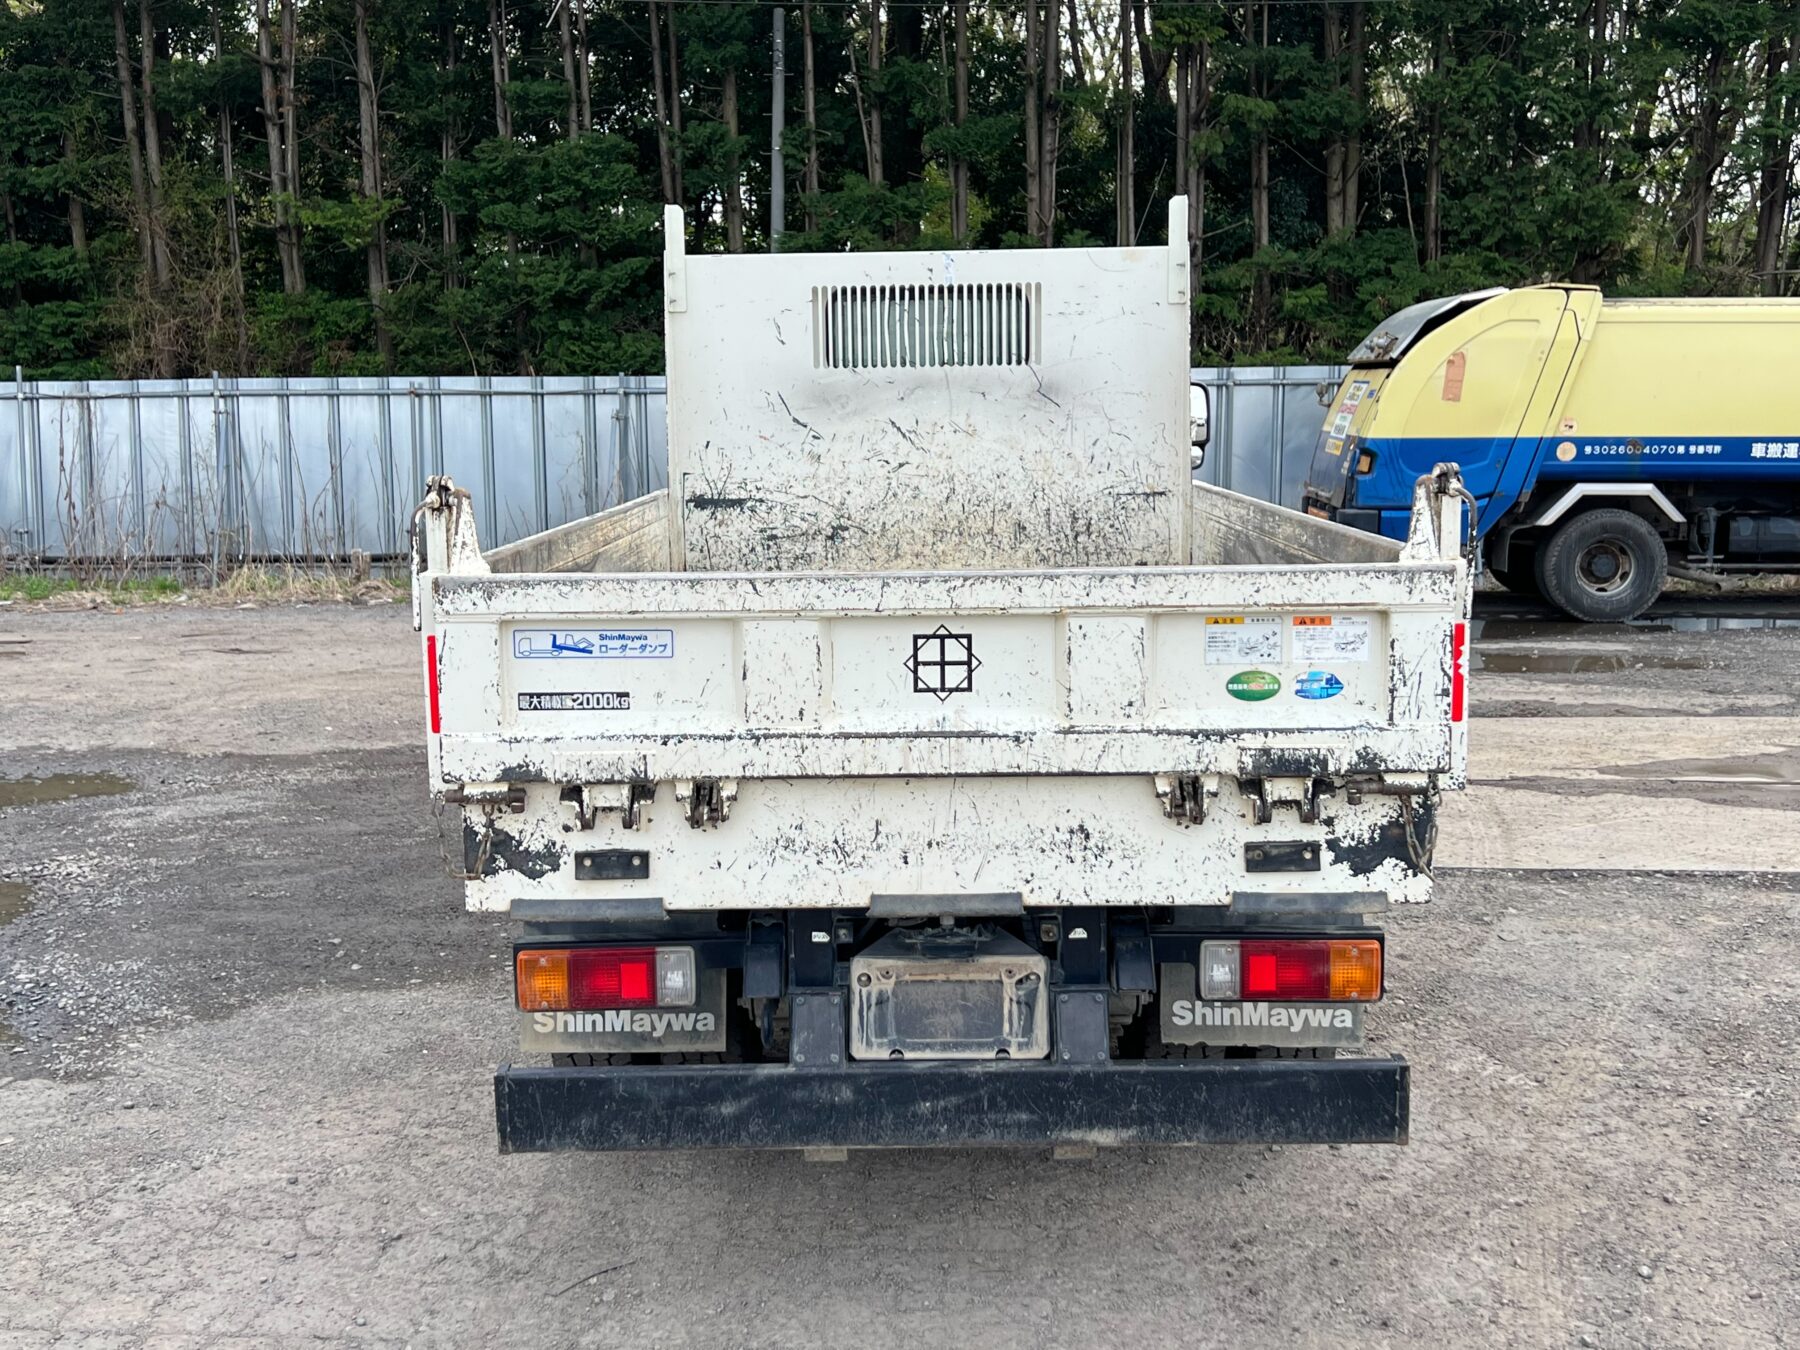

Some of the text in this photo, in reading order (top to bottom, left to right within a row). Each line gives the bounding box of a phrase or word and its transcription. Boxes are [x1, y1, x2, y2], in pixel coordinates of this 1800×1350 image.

[599, 633, 648, 643] ShinMaywa
[599, 643, 668, 654] ローダーダンプ
[533, 1010, 715, 1037] ShinMaywa
[1171, 1000, 1353, 1032] ShinMaywa
